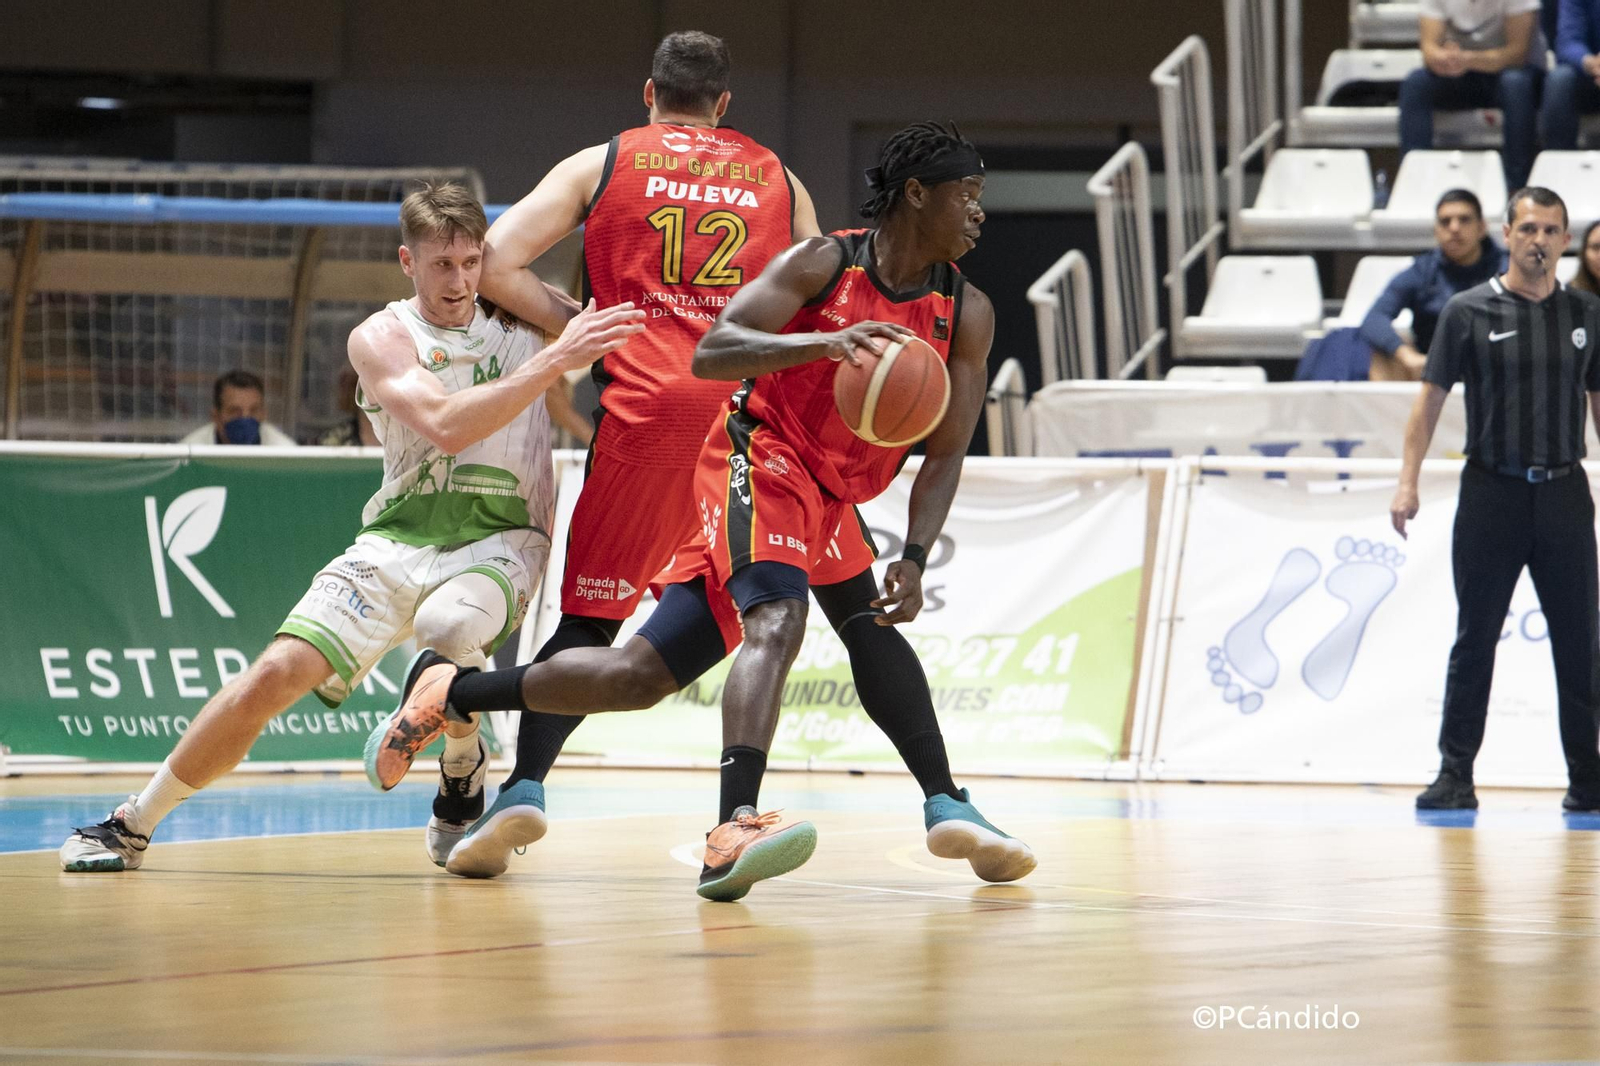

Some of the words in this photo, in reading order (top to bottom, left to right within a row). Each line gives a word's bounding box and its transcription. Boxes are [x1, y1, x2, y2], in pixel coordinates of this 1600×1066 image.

[634, 152, 679, 171] EDU
[688, 157, 769, 187] GATELL
[645, 176, 759, 208] PULEVA
[645, 205, 748, 286] 12
[473, 354, 501, 387] 44
[575, 585, 615, 601] Digital
[1022, 631, 1080, 676] 41
[58, 715, 93, 737] TU
[103, 715, 191, 738] PUNTO
